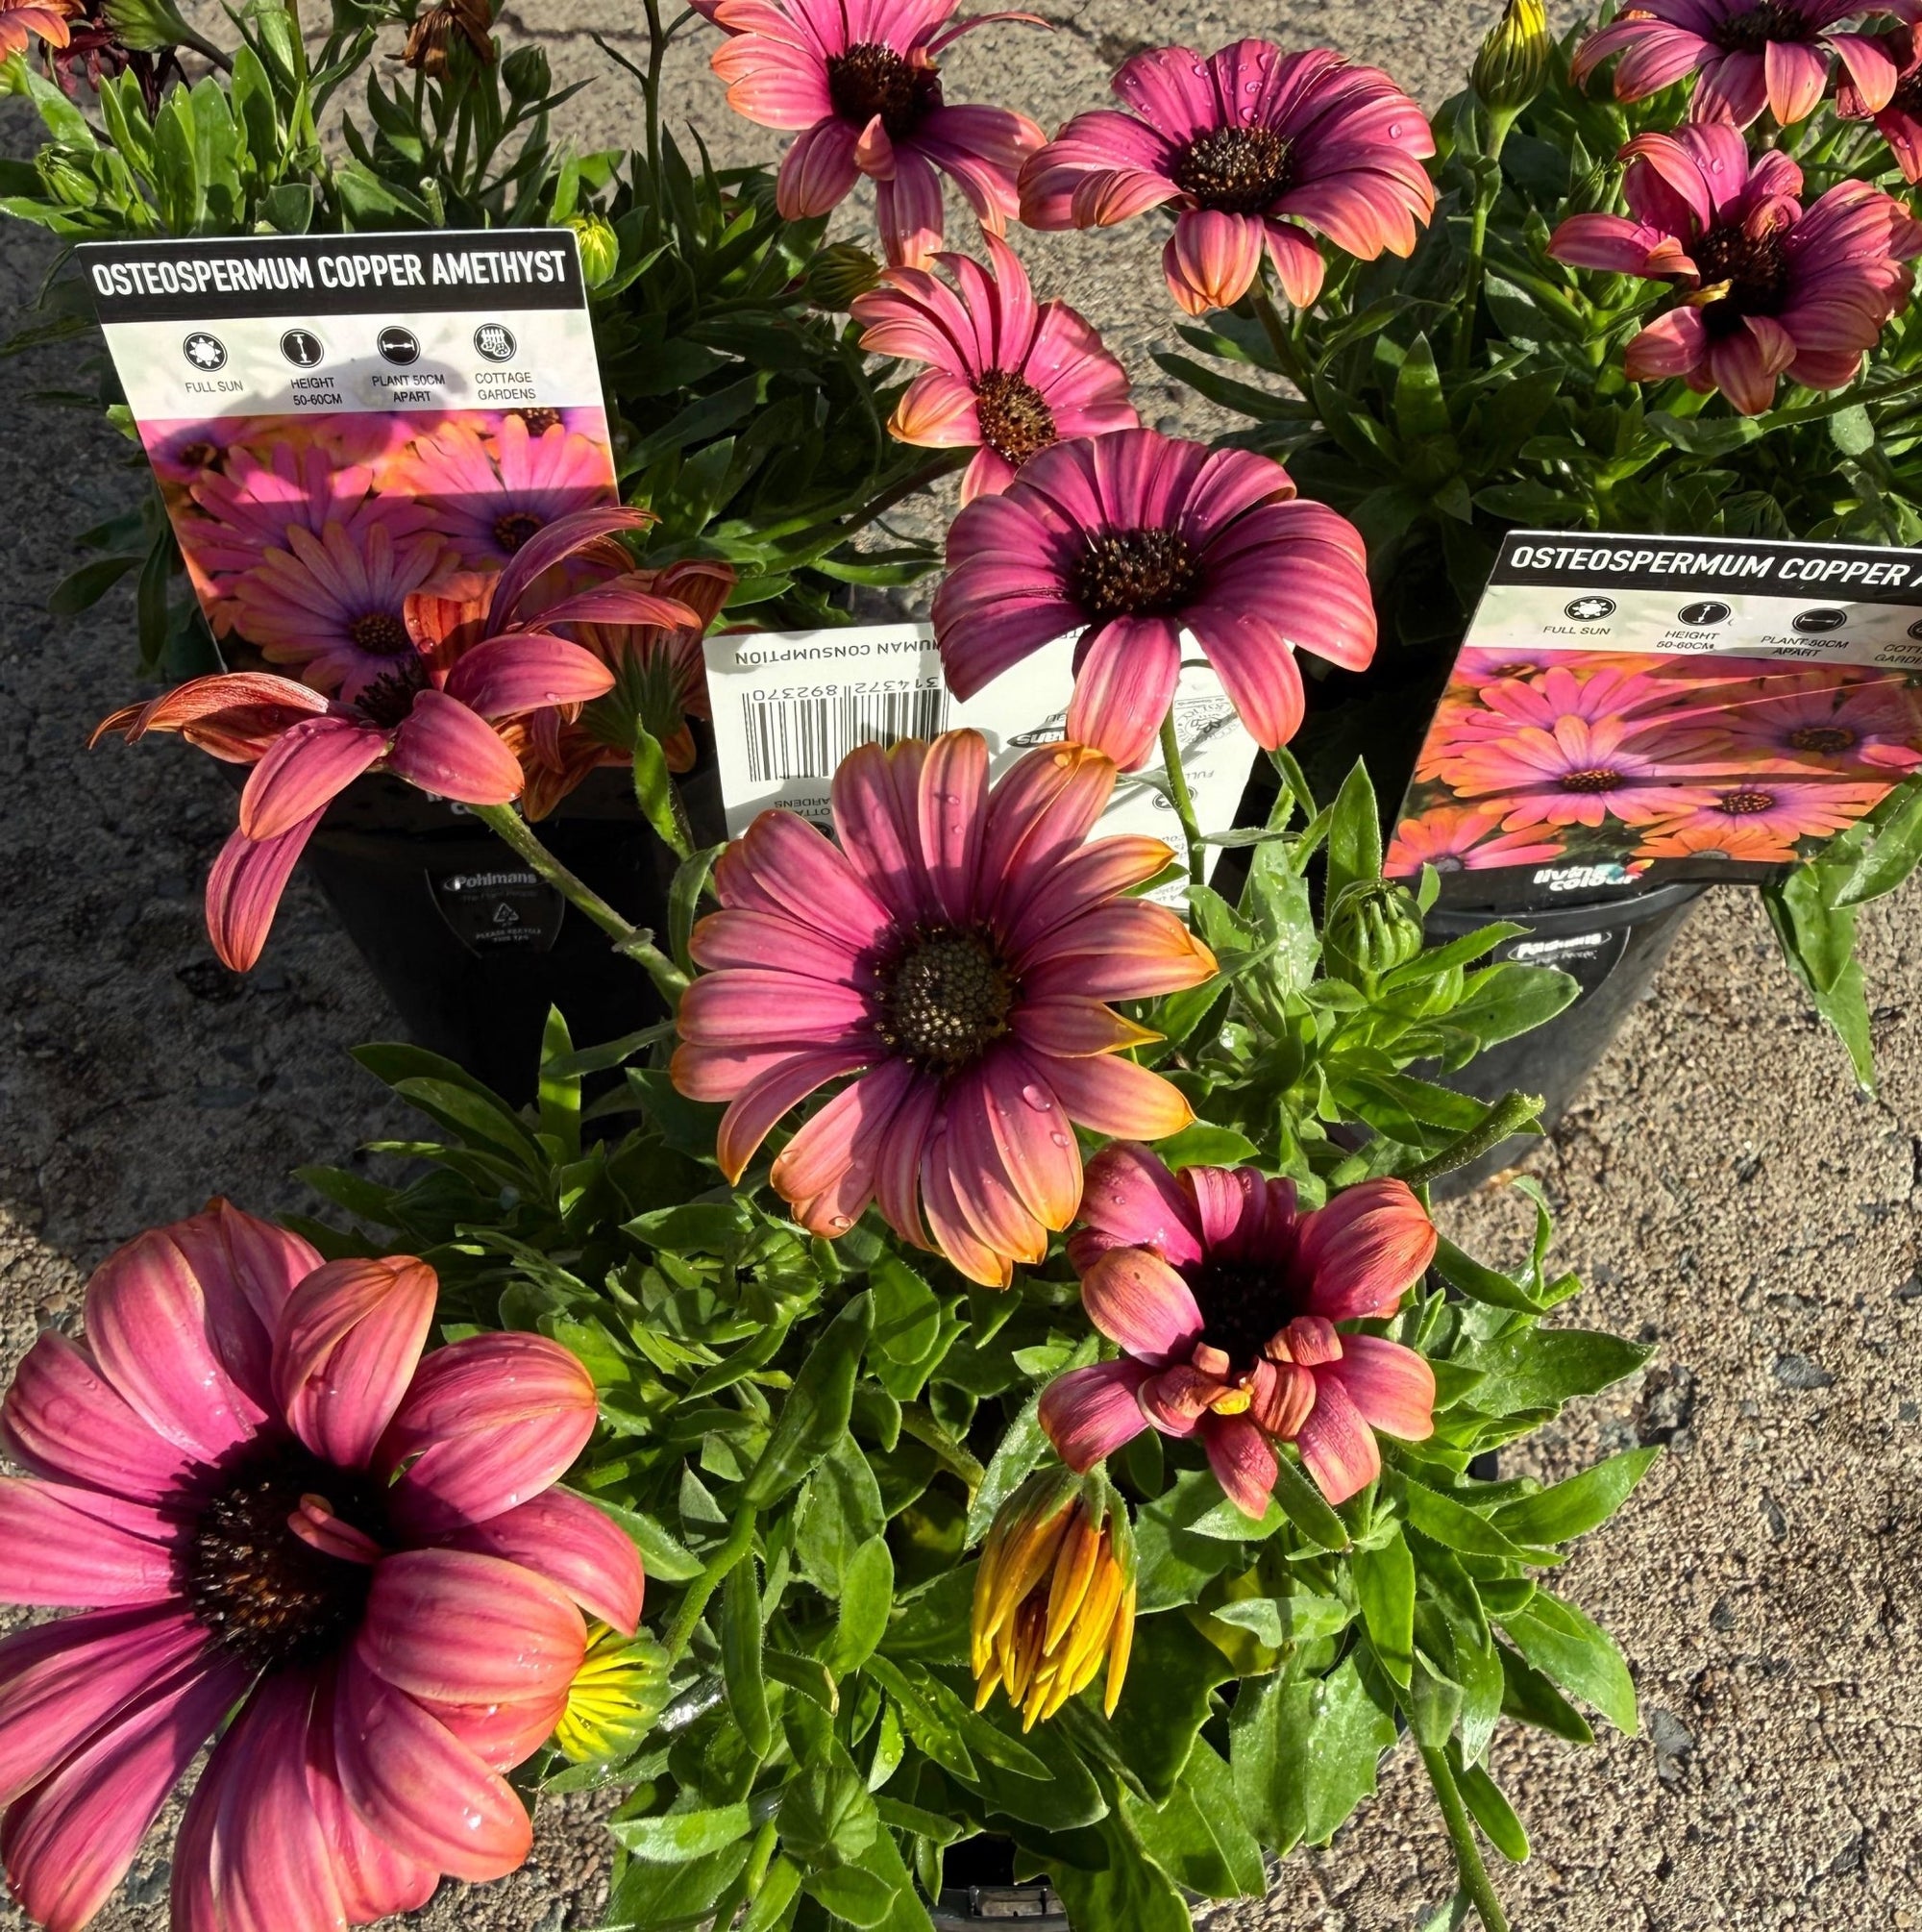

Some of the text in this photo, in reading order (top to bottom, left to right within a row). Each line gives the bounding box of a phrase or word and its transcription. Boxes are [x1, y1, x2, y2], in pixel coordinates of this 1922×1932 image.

[92, 250, 566, 296] OSTEOSPERMUM COPPER AMETHYST
[290, 376, 334, 390] HEIGHT
[372, 373, 445, 387] PLANT 50CM
[475, 372, 532, 385] COTTAGE
[185, 380, 243, 394] FULL SUN
[478, 386, 536, 401] GARDENS
[293, 392, 343, 406] 50-60CM
[393, 389, 431, 404] APART
[1510, 545, 1775, 579] OSTEOSPERMUM
[1778, 557, 1910, 586] COPPER
[1542, 626, 1612, 636] FULL SUN
[1664, 631, 1720, 641] HEIGHT
[1761, 635, 1810, 648] PLANT
[1884, 643, 1922, 654] COTT
[735, 645, 871, 665] CONSUMPTION
[1771, 646, 1822, 657] APART
[752, 677, 939, 702] 314372 892370
[774, 797, 830, 808] ARDENS
[455, 872, 537, 891] Pohlmans
[1533, 865, 1613, 884] living
[1549, 874, 1638, 892] colour
